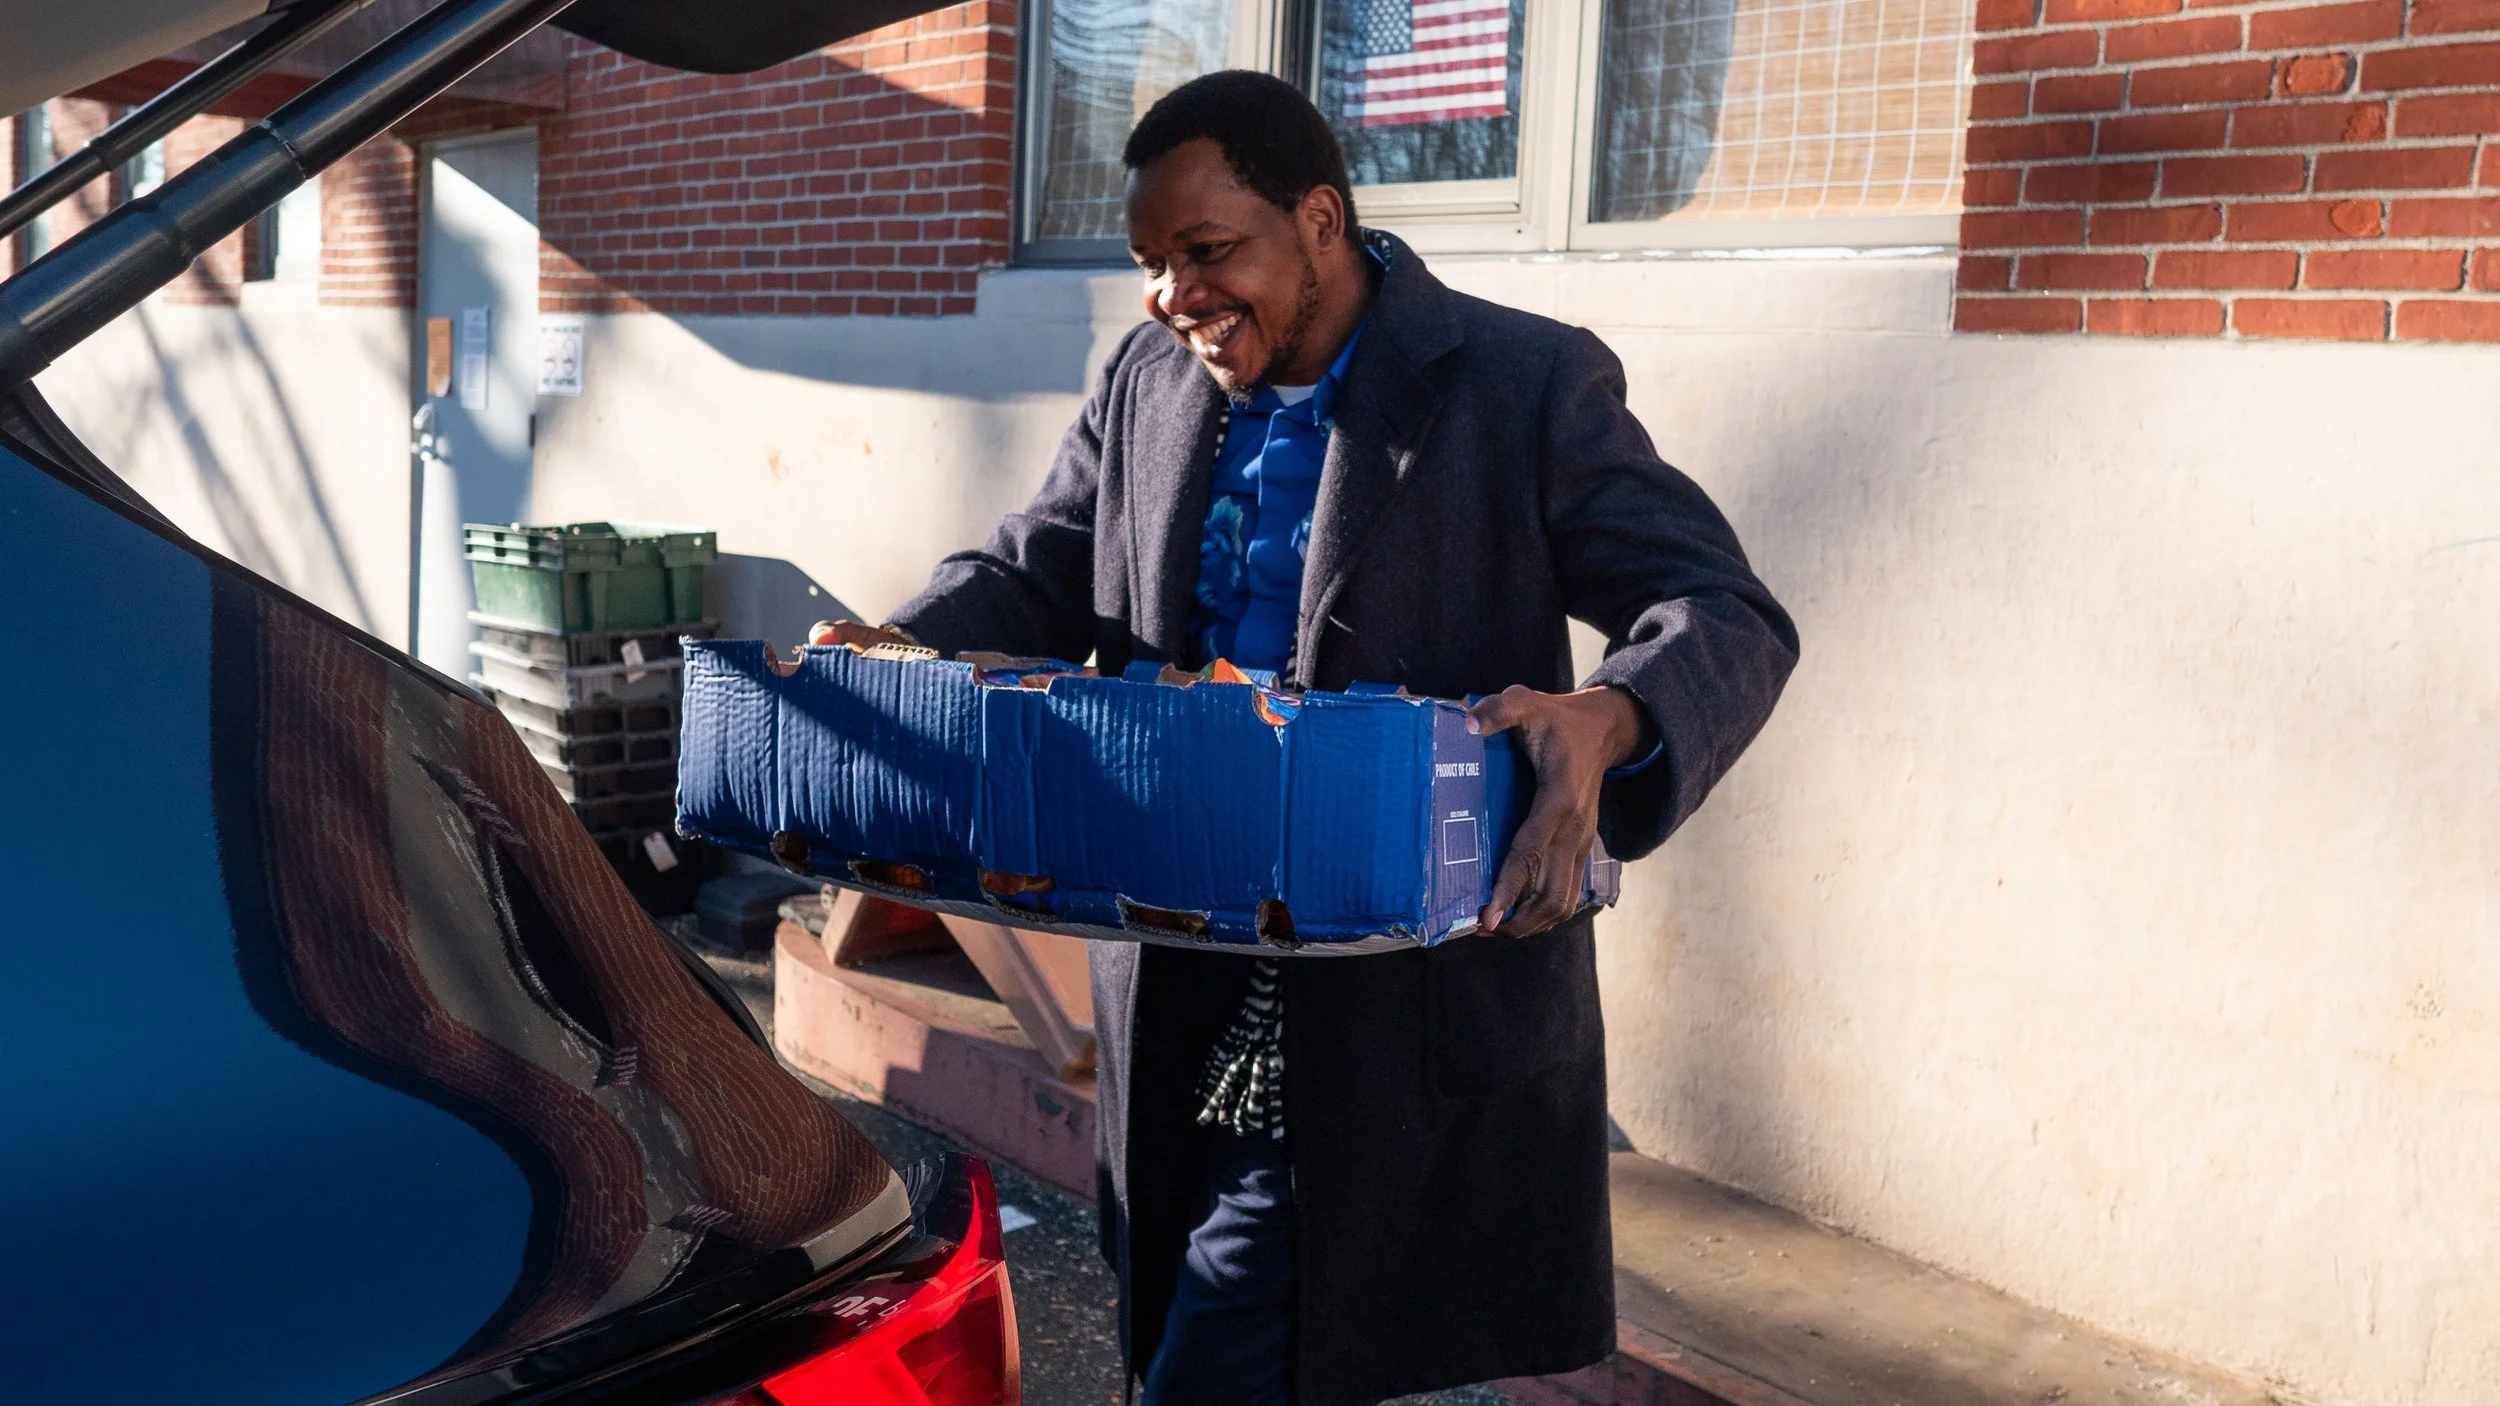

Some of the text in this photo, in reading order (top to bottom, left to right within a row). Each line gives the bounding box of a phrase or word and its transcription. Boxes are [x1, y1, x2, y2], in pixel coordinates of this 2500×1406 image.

[1435, 762, 1480, 778] PRODUCT OF CHILE
